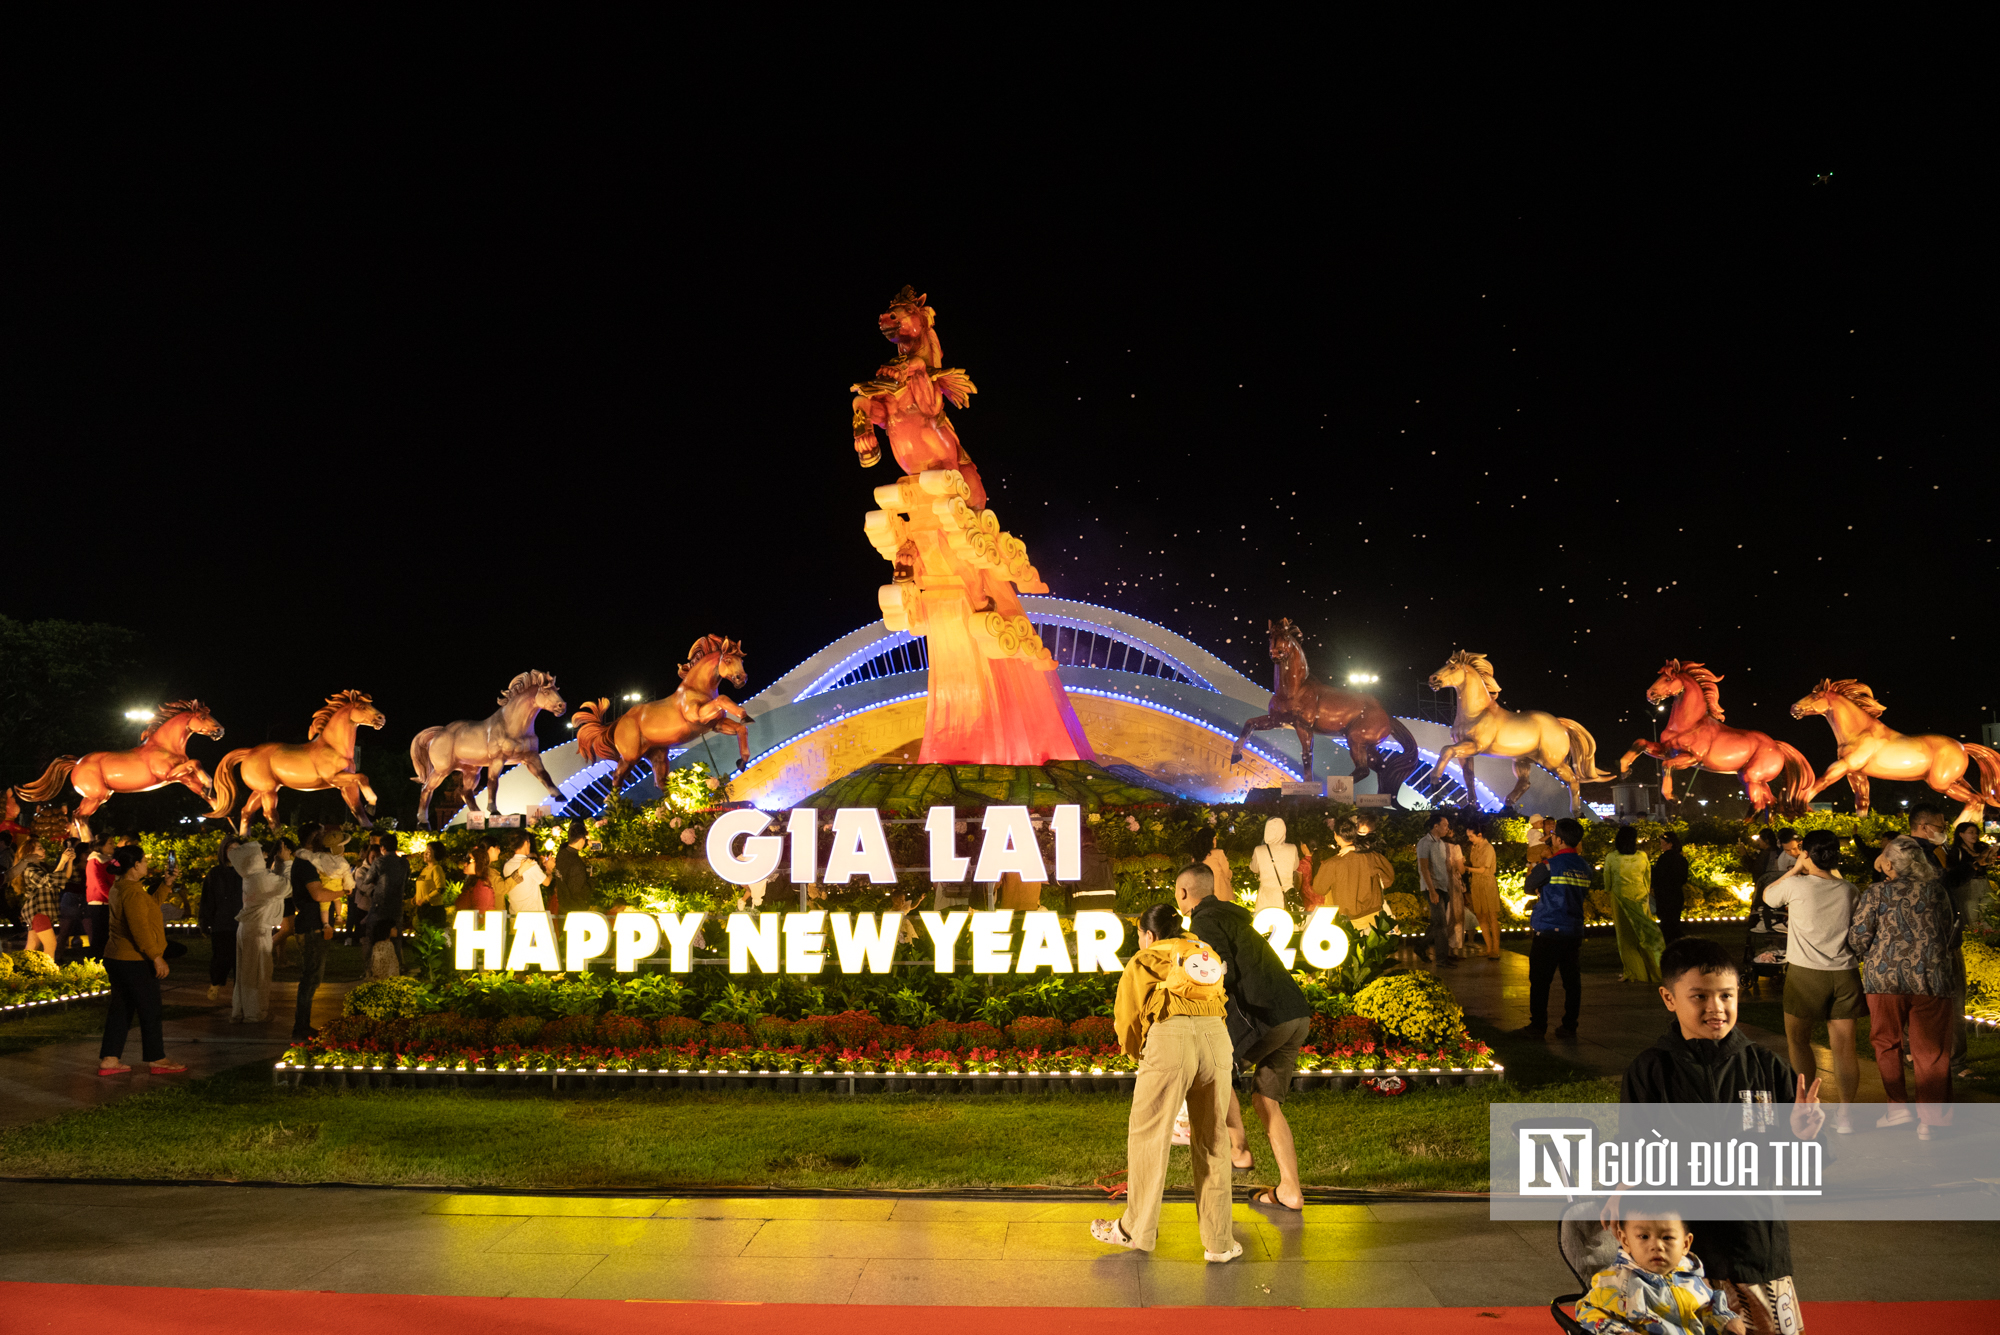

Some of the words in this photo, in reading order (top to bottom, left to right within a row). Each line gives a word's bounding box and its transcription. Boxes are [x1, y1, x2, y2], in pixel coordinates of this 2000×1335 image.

[706, 807, 899, 884] GIA
[925, 804, 1081, 882] LAI
[453, 910, 708, 973] HAPPY
[725, 910, 904, 974] NEW
[919, 909, 1125, 974] YEAR
